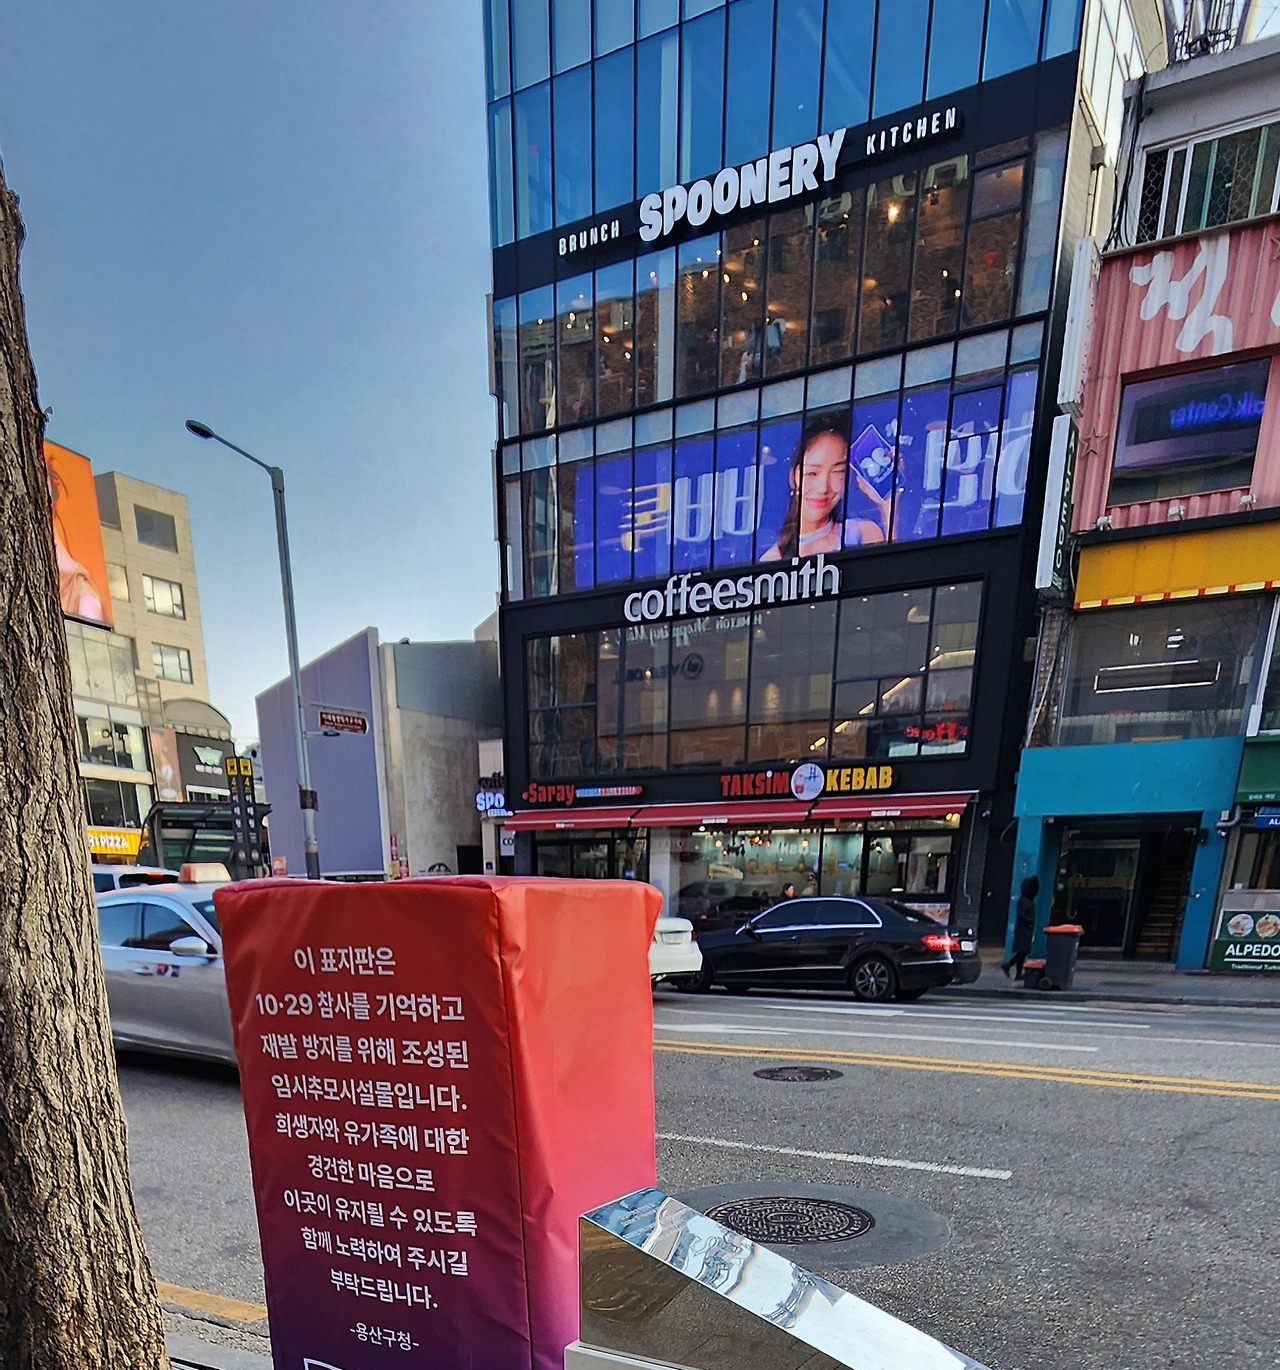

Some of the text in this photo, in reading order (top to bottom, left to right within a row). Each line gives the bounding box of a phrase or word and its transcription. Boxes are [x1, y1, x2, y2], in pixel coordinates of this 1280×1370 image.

[558, 107, 958, 257] BRUNCH SPOONERY KITCHEN
[1055, 430, 1075, 569] ALPEDO
[623, 554, 841, 622] coffeesmith
[529, 782, 575, 806] Saray
[826, 765, 893, 792] KEBAB
[476, 792, 505, 811] SPO
[294, 946, 396, 976] 이 표지판은
[1225, 944, 1280, 956] ALPEDO
[255, 991, 465, 1023] 10·29 참사를 기억하고
[260, 1034, 470, 1069] 재발 방지를 위해 조성된
[271, 1074, 468, 1112] 임시추모시설물입니다.
[276, 1113, 470, 1155] 희생자와 유가족에 대한
[307, 1155, 436, 1192] 경건한 마음으로
[283, 1189, 478, 1236] 이곳이 유지될 수 있도록
[301, 1226, 469, 1276] 함께 노력하여 주시길
[331, 1268, 438, 1309] 부탁드립니다.
[350, 1322, 420, 1352] -용산구청-
